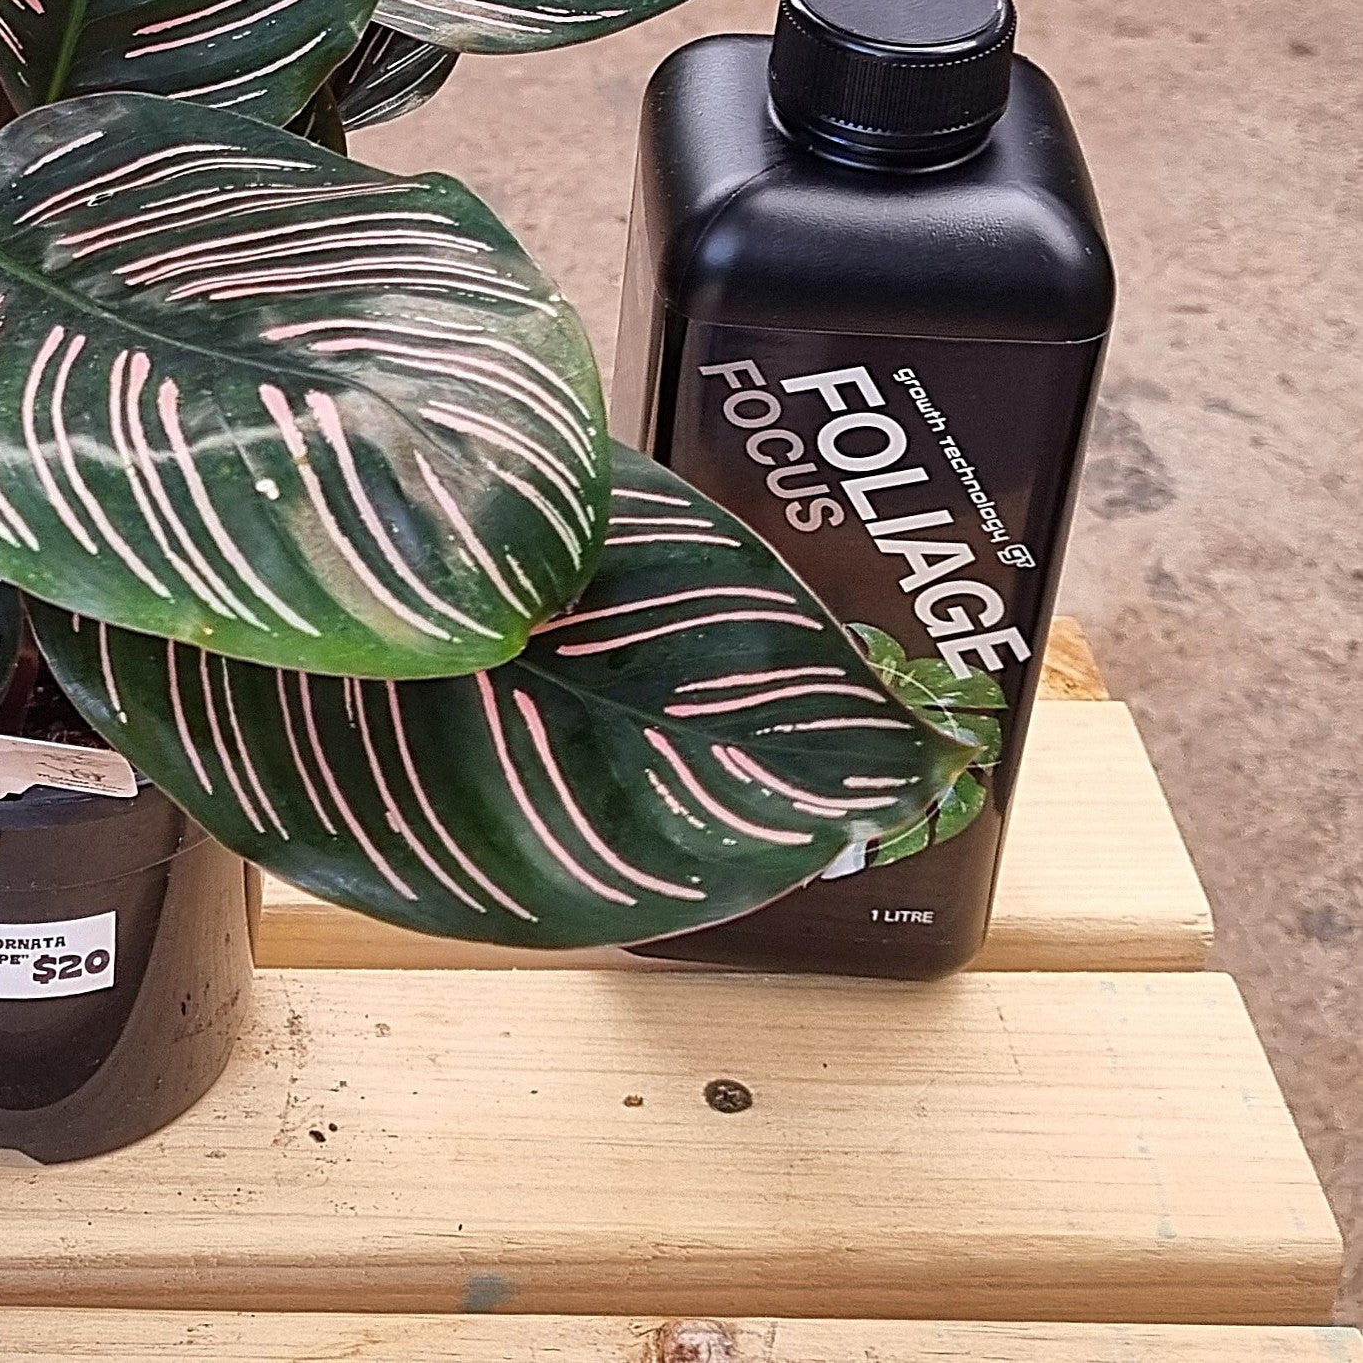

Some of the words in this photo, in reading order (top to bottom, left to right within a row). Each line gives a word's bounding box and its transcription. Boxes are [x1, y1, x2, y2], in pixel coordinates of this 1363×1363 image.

[893, 368, 947, 432] growth
[698, 359, 846, 533] FOCUS
[780, 366, 1032, 680] FOLIAGE
[870, 909, 878, 922] 1
[884, 909, 934, 923] LITRE
[32, 949, 110, 985] $20
